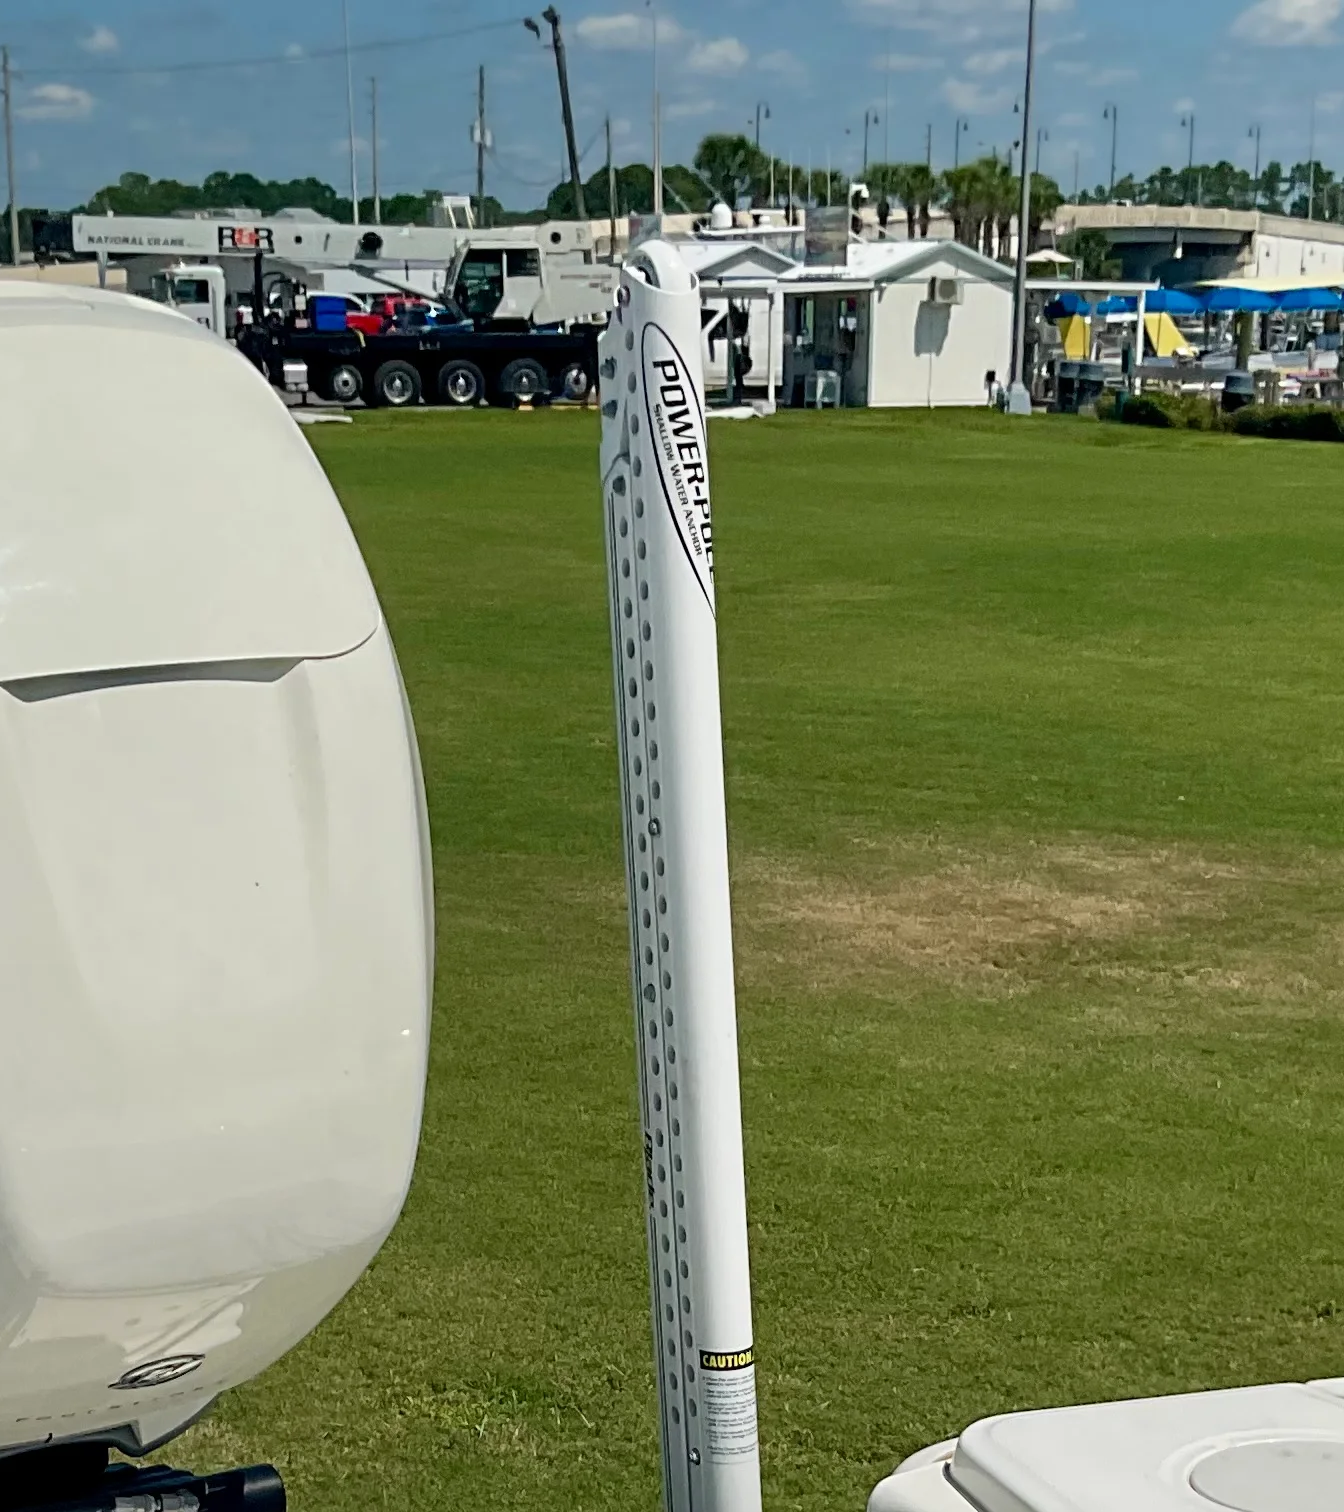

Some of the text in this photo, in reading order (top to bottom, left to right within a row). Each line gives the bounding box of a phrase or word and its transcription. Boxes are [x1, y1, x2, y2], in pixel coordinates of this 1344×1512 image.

[87, 235, 144, 246] NATIONAL
[147, 237, 185, 247] CRANE
[652, 358, 715, 584] POWER-POL
[653, 403, 703, 556] SHALLOW WATER ANCHOR
